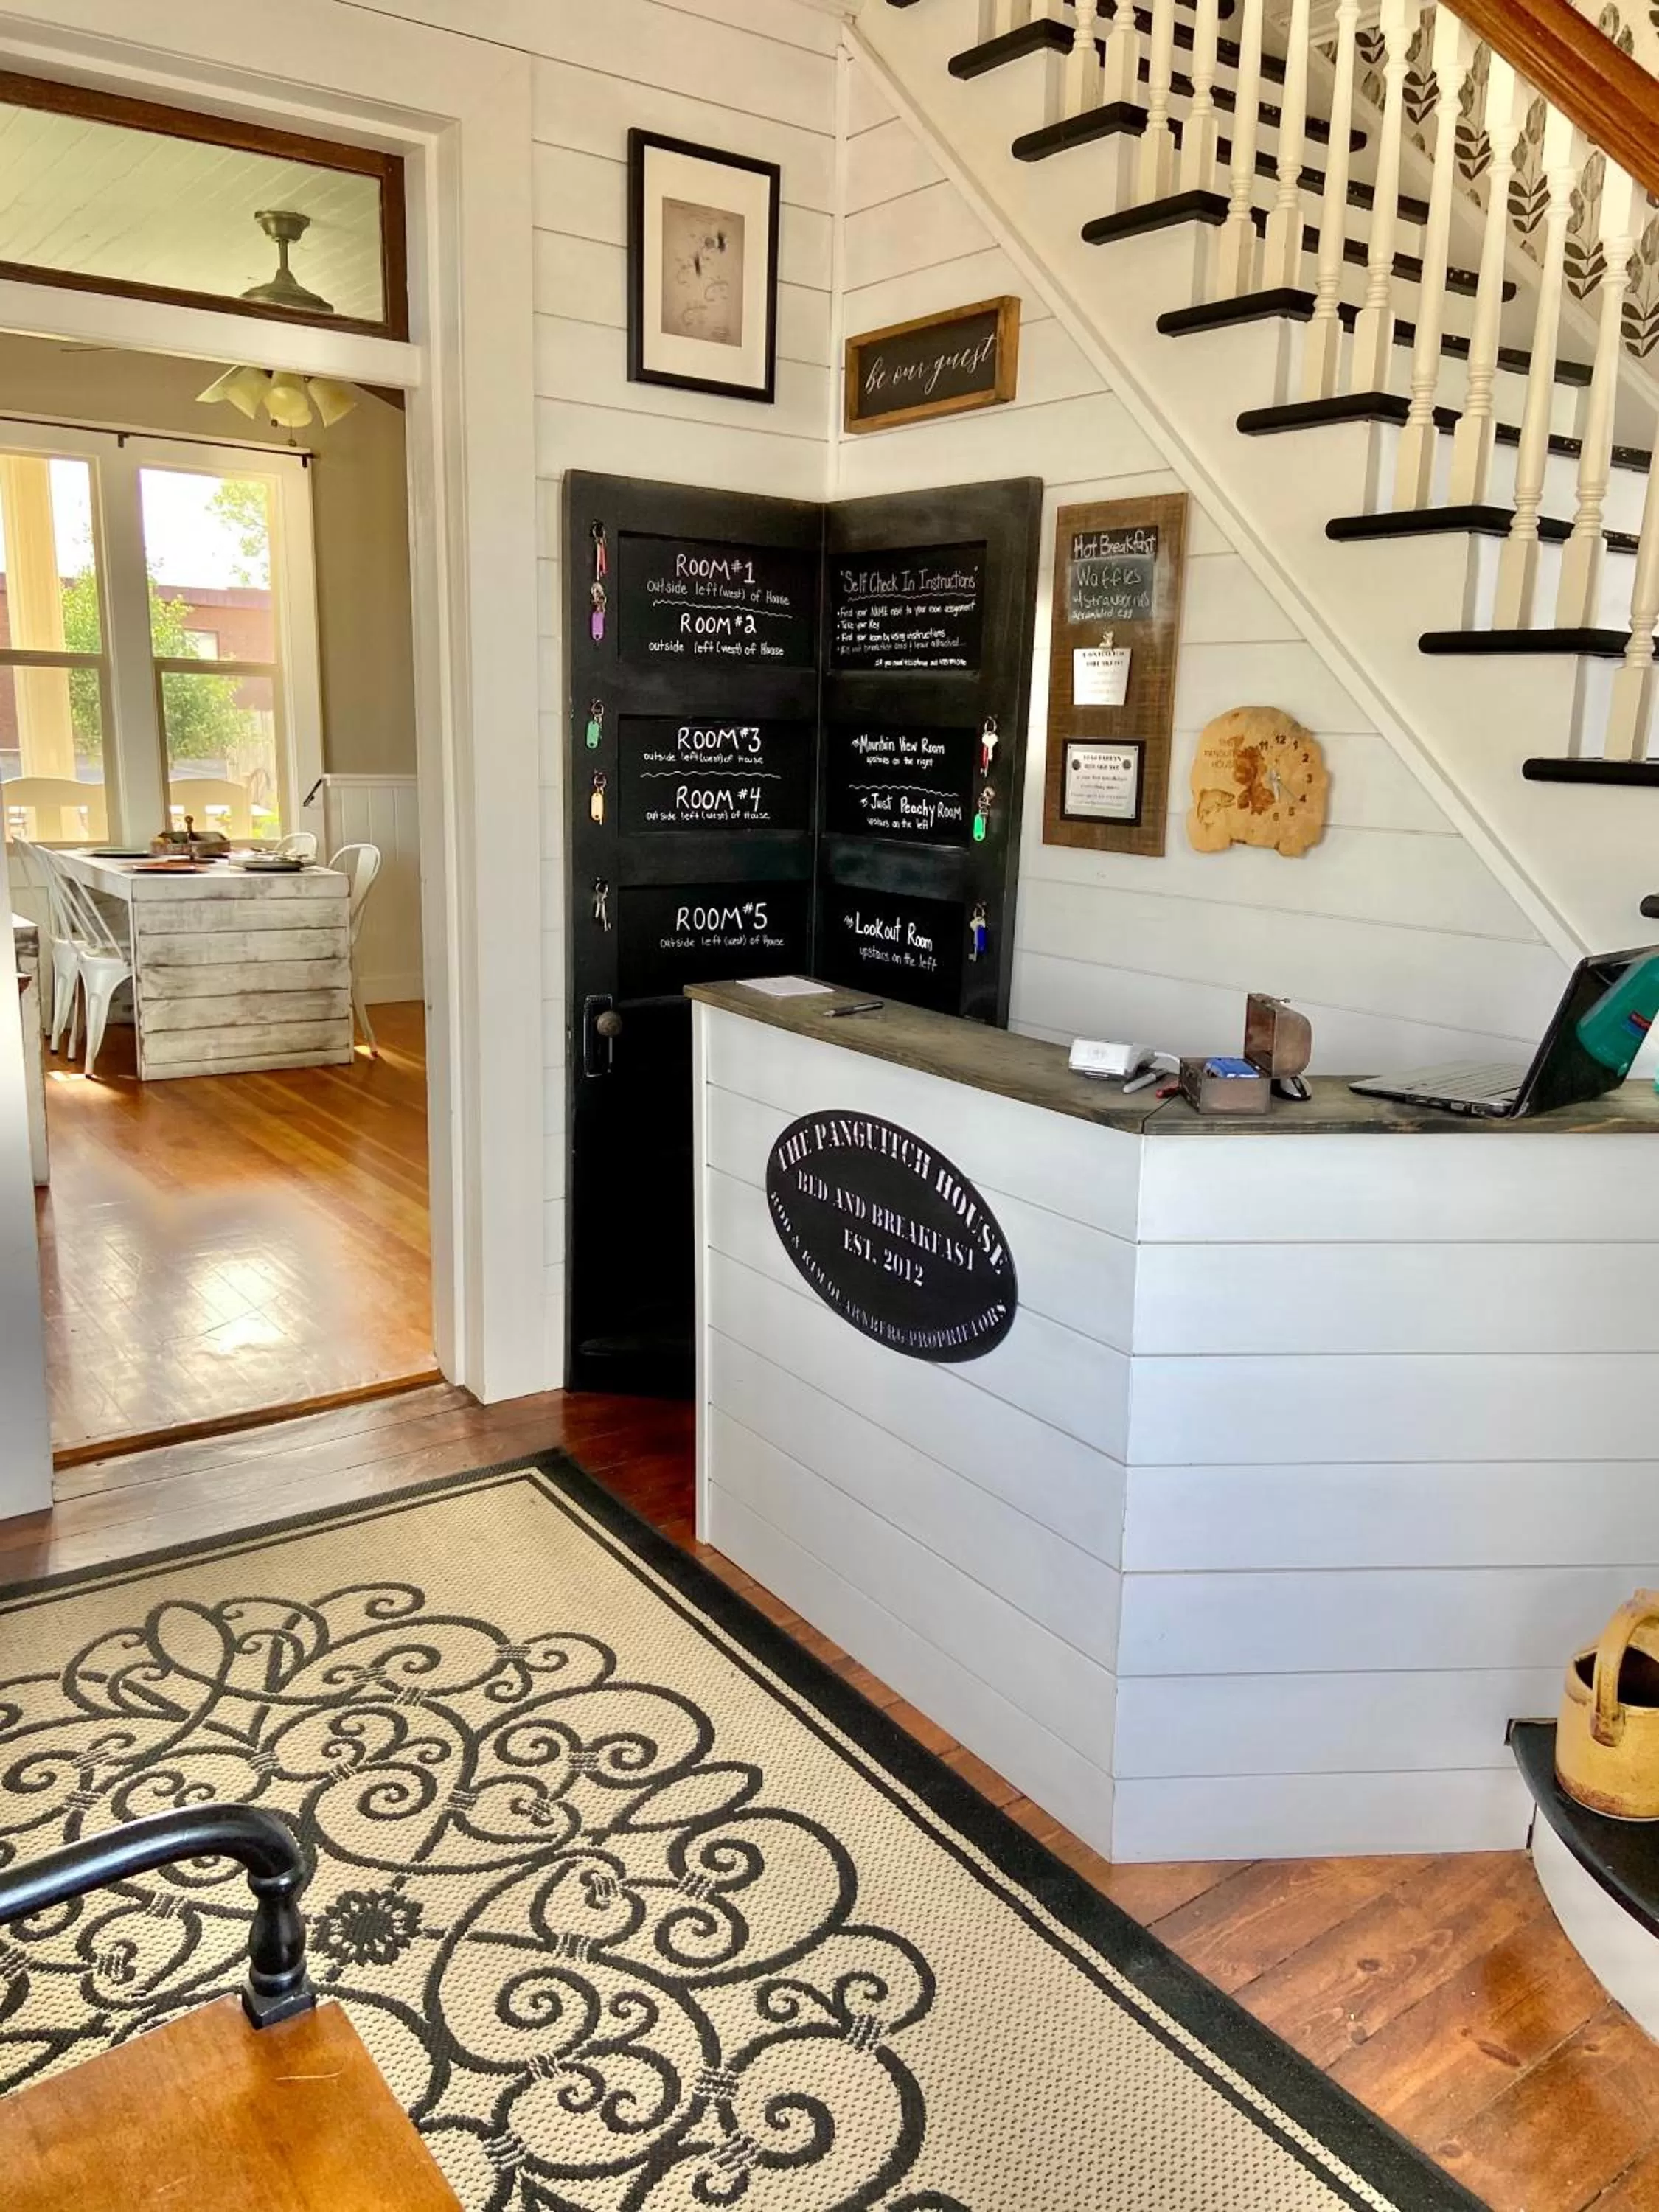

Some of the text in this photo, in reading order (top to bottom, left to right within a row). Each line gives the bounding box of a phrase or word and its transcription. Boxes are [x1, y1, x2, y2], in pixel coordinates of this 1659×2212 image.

[864, 333, 997, 395] be our guest
[1074, 529, 1157, 559] Hot Breakfast
[869, 570, 899, 594] Check
[901, 570, 915, 593] In
[750, 591, 762, 603] of
[744, 641, 757, 655] of
[858, 733, 945, 755] Mountain View Room
[1259, 740, 1269, 751] 11
[1275, 734, 1287, 745] 12
[891, 757, 900, 765] on
[917, 757, 934, 770] right
[1301, 752, 1310, 763] 2
[1306, 773, 1313, 784] 3
[1298, 793, 1307, 804] 4
[731, 810, 741, 820] of
[870, 792, 894, 810] Just
[900, 795, 936, 828] Peachy
[891, 819, 900, 829] on
[916, 816, 929, 830] left
[749, 934, 760, 946] of
[906, 922, 933, 952] Room
[859, 945, 939, 973] upstairs on the left
[775, 1119, 1009, 1276] THE PANGUITCH HOUSE
[832, 1186, 867, 1220] AND
[871, 1203, 974, 1271] BREAKFAST
[844, 1228, 924, 1288] EST. 2012
[909, 1298, 1007, 1349] PROPRIETORS
